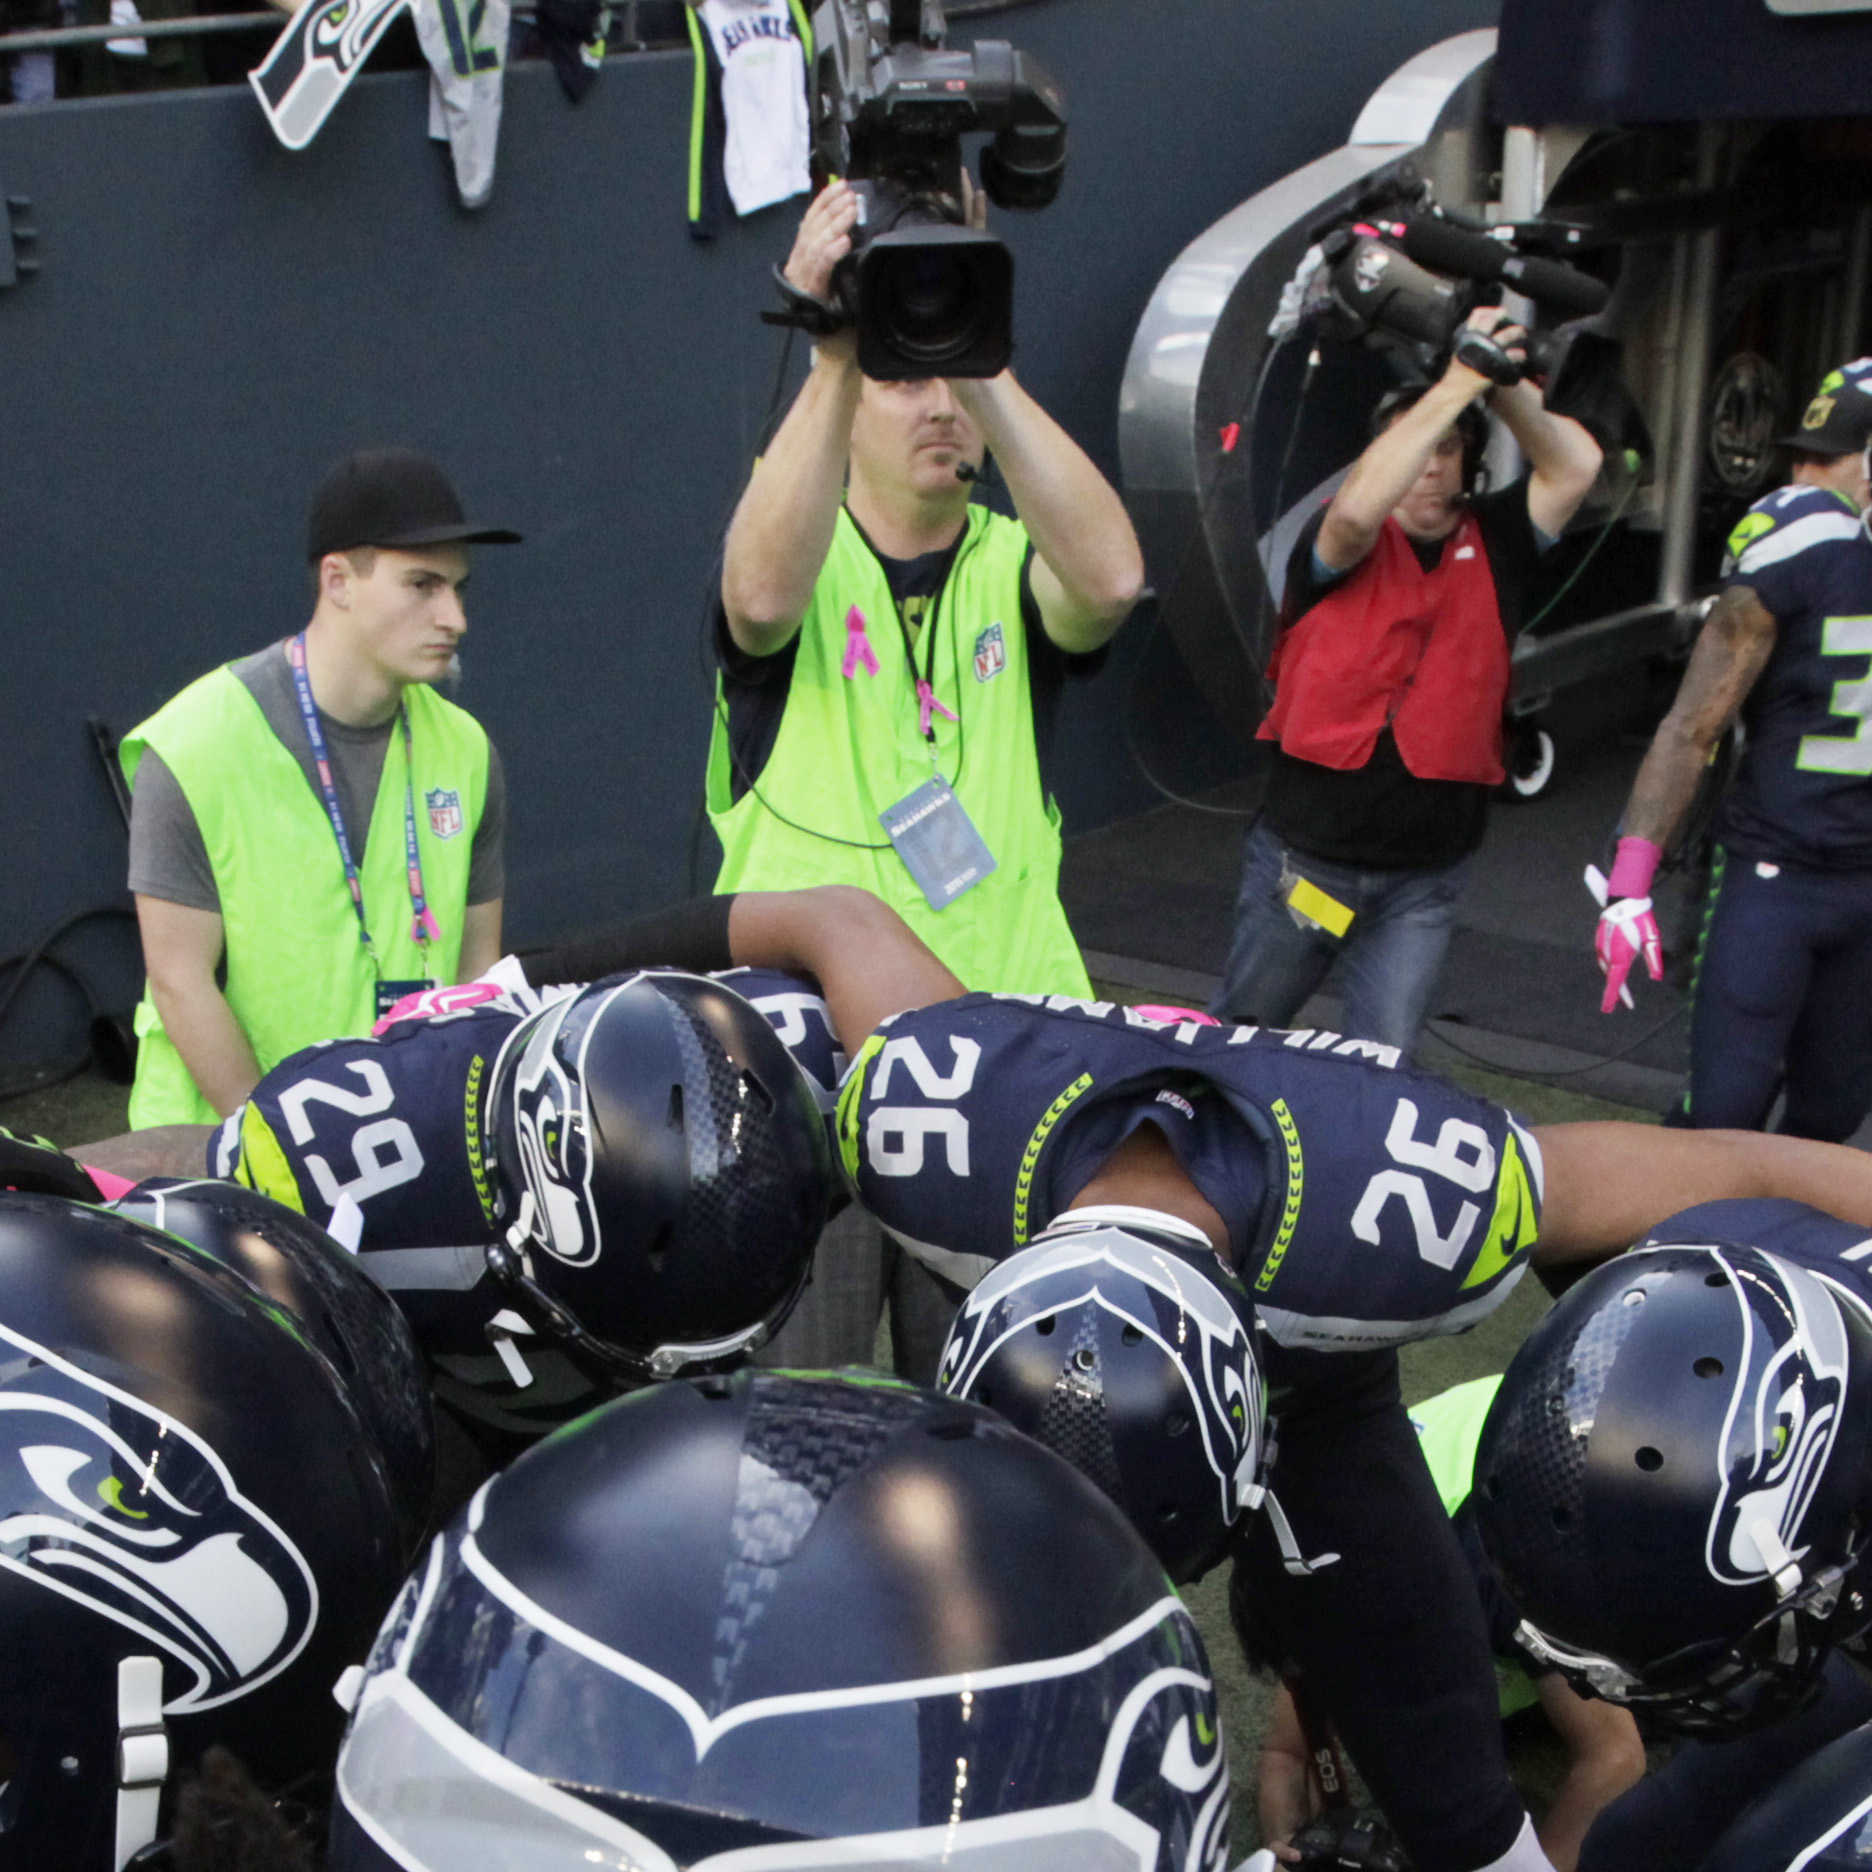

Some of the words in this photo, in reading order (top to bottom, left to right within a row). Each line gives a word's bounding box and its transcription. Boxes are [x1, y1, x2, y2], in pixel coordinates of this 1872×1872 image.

[430, 807, 461, 831] NFL
[277, 1058, 425, 1206] 29
[867, 1034, 981, 1178] 26
[1349, 1097, 1497, 1272] 26
[1314, 1748, 1339, 1793] EOS
